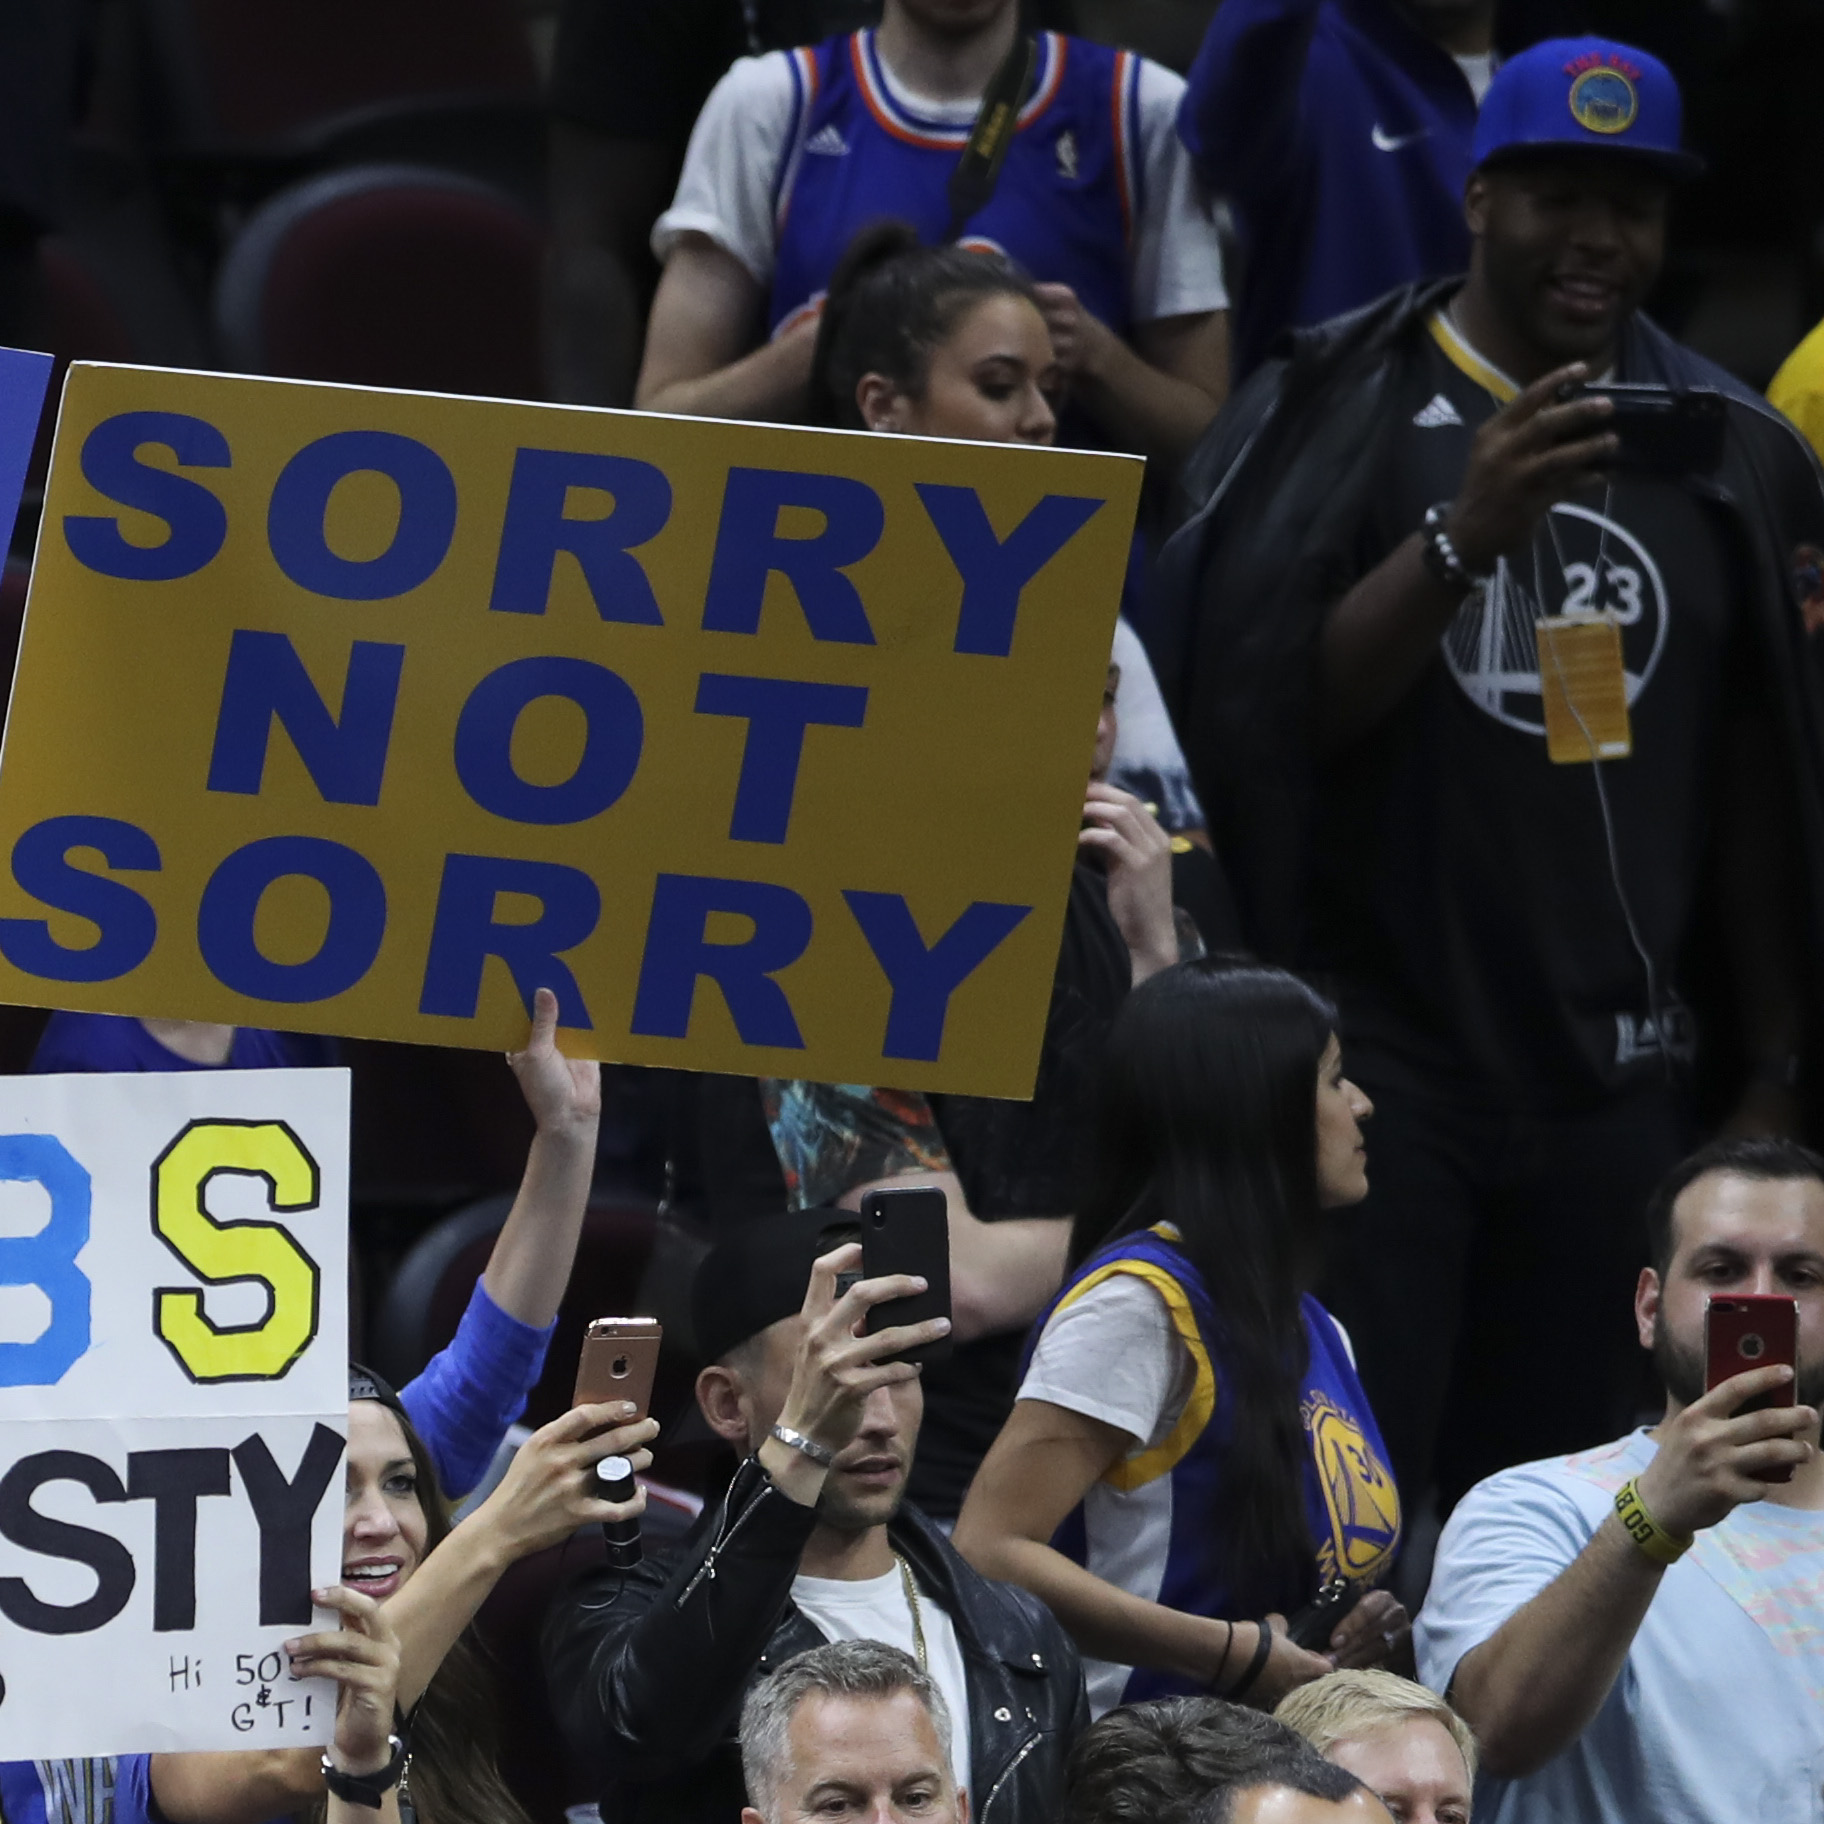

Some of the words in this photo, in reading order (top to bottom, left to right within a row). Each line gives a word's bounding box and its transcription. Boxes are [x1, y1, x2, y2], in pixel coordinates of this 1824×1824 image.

[62, 410, 1107, 658] SORRY
[1561, 562, 1643, 626] 23
[205, 628, 868, 844] NOT
[1624, 1509, 1654, 1544] GO
[169, 1654, 202, 1692] Hi
